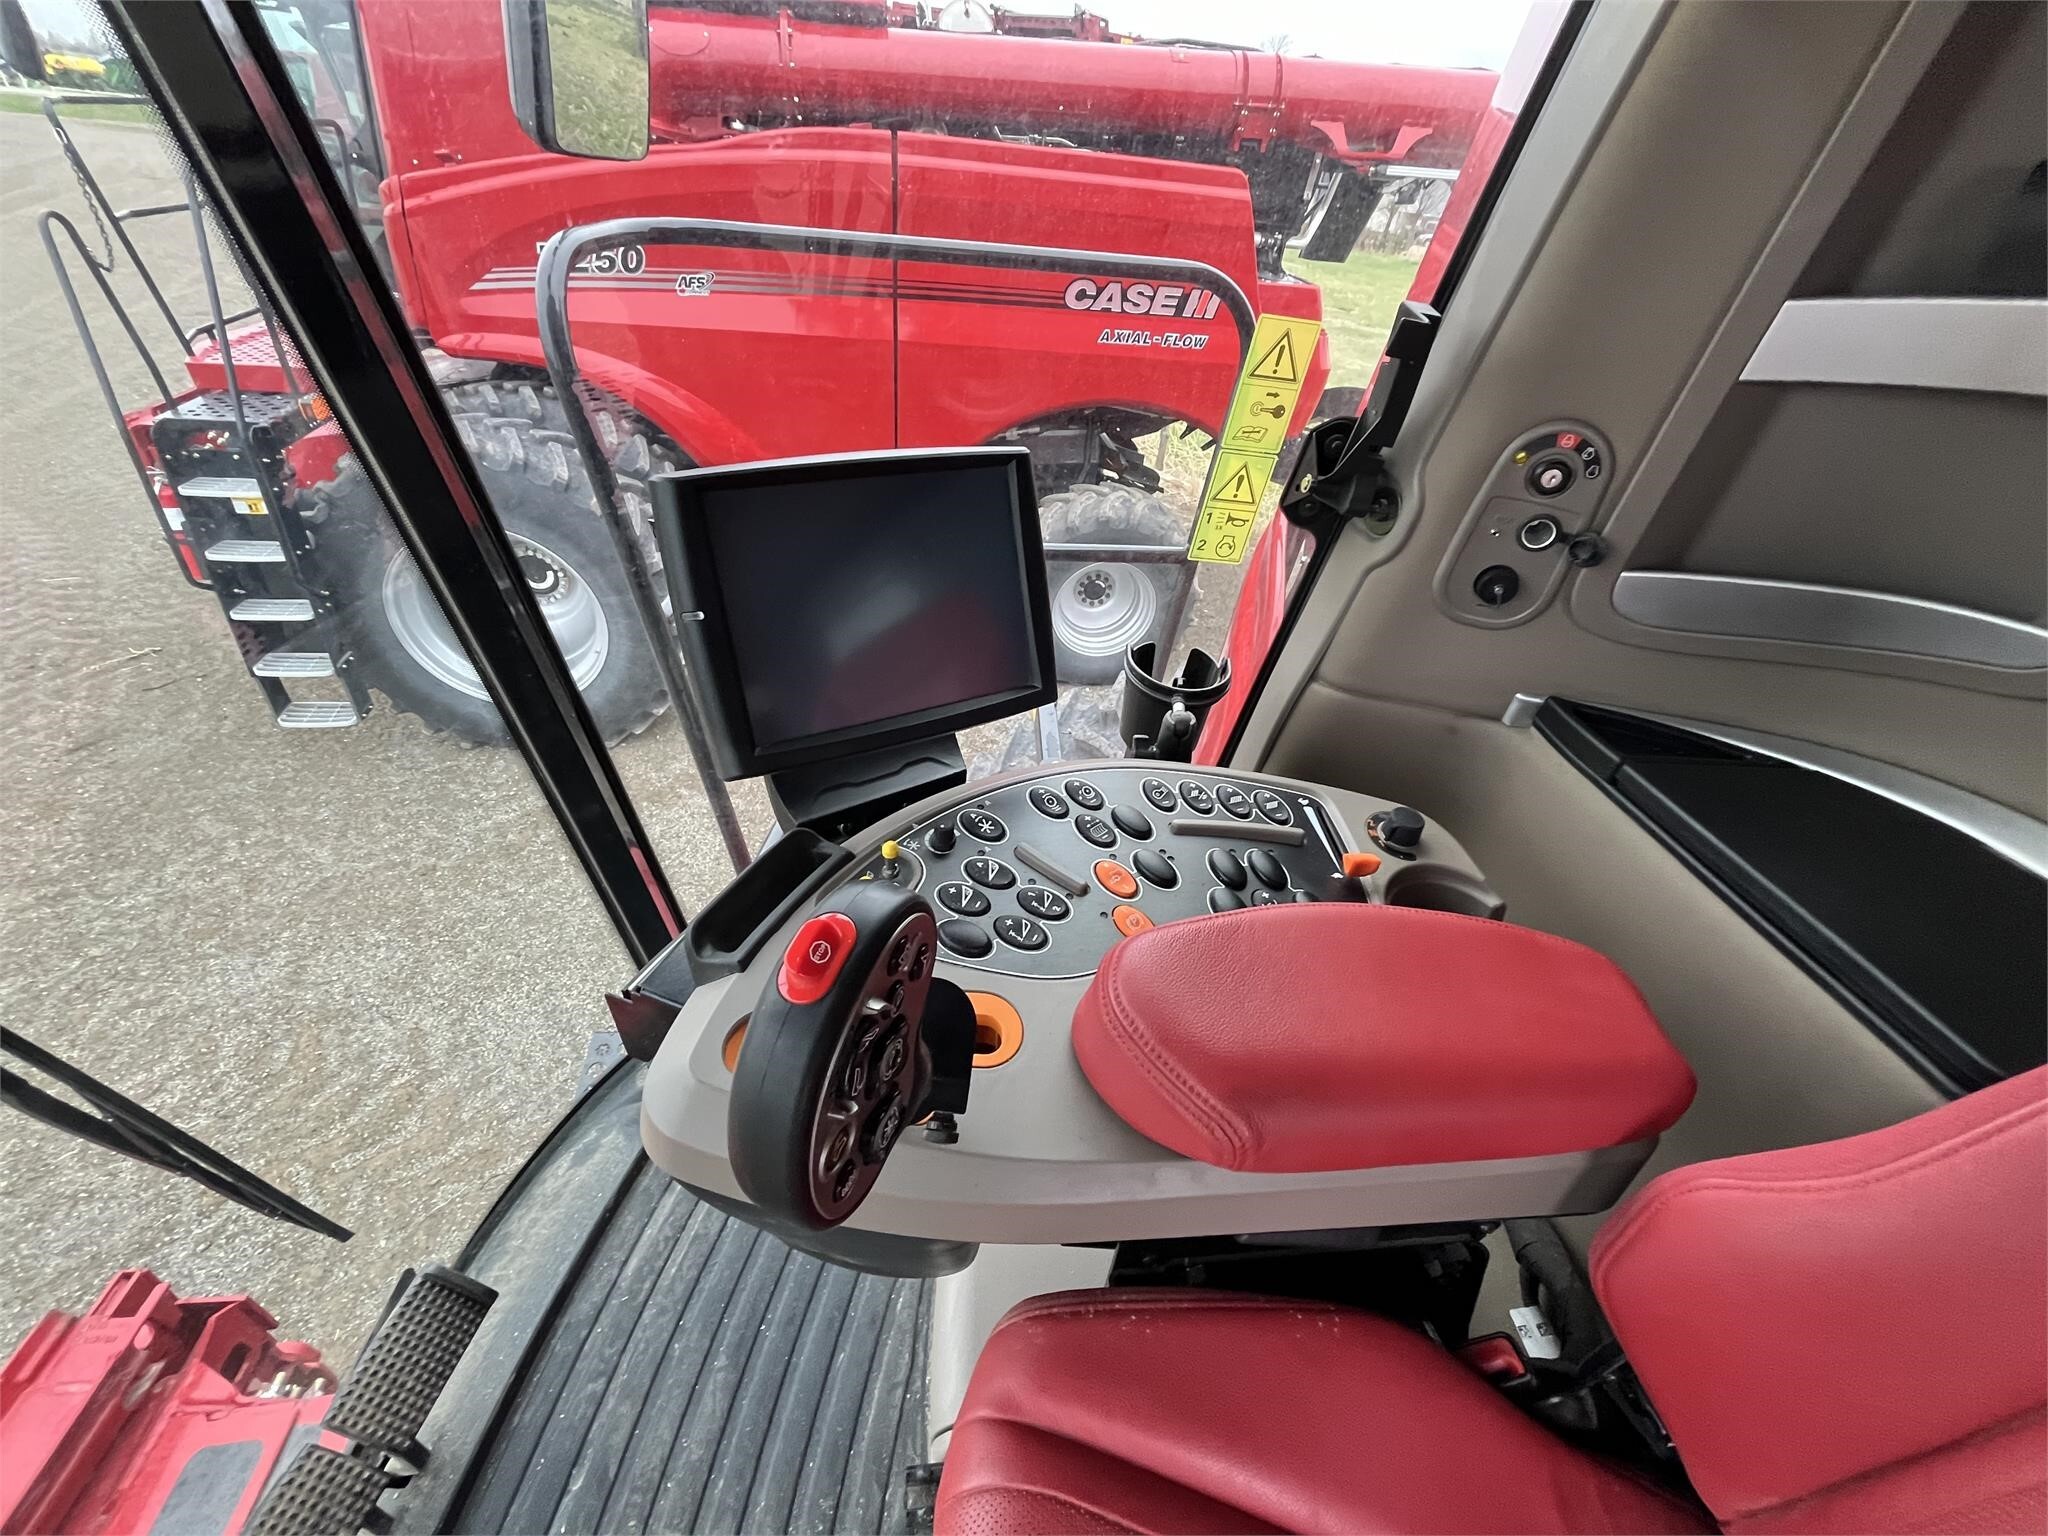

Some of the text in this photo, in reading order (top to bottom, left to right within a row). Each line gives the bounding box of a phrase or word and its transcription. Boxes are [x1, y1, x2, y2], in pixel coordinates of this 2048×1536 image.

[677, 275, 706, 289] AFS
[1064, 278, 1184, 317] CASE
[1206, 512, 1213, 525] 1
[1196, 538, 1207, 551] 2
[813, 943, 827, 961] STOP
